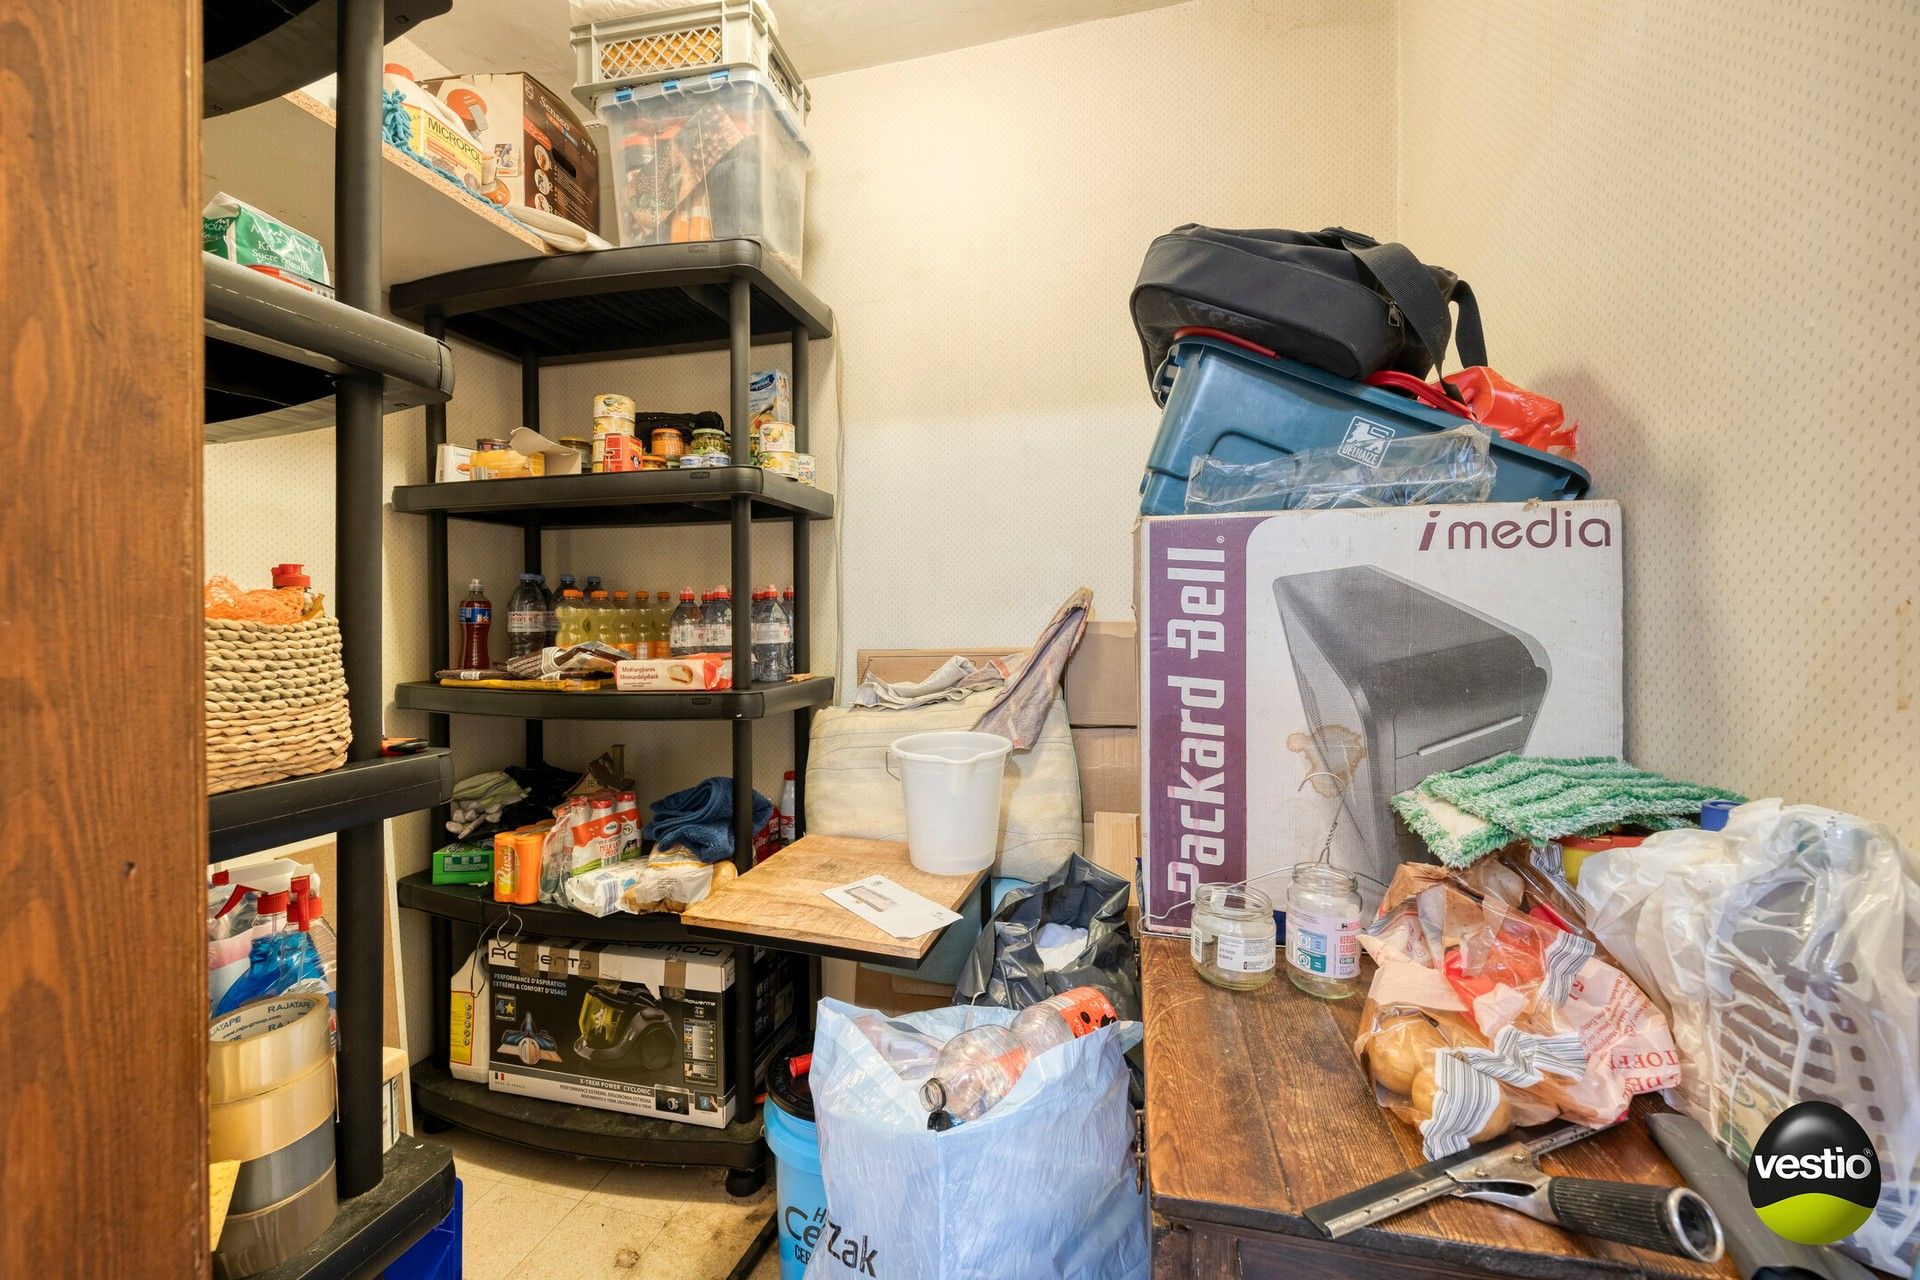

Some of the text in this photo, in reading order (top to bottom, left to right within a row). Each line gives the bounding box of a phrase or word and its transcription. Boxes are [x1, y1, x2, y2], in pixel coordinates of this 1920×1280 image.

[1342, 443, 1379, 465] DELHAIZE
[1167, 675, 1225, 897] Packard
[521, 984, 544, 993] CONFORT
[623, 1085, 652, 1095] CYCLONIC
